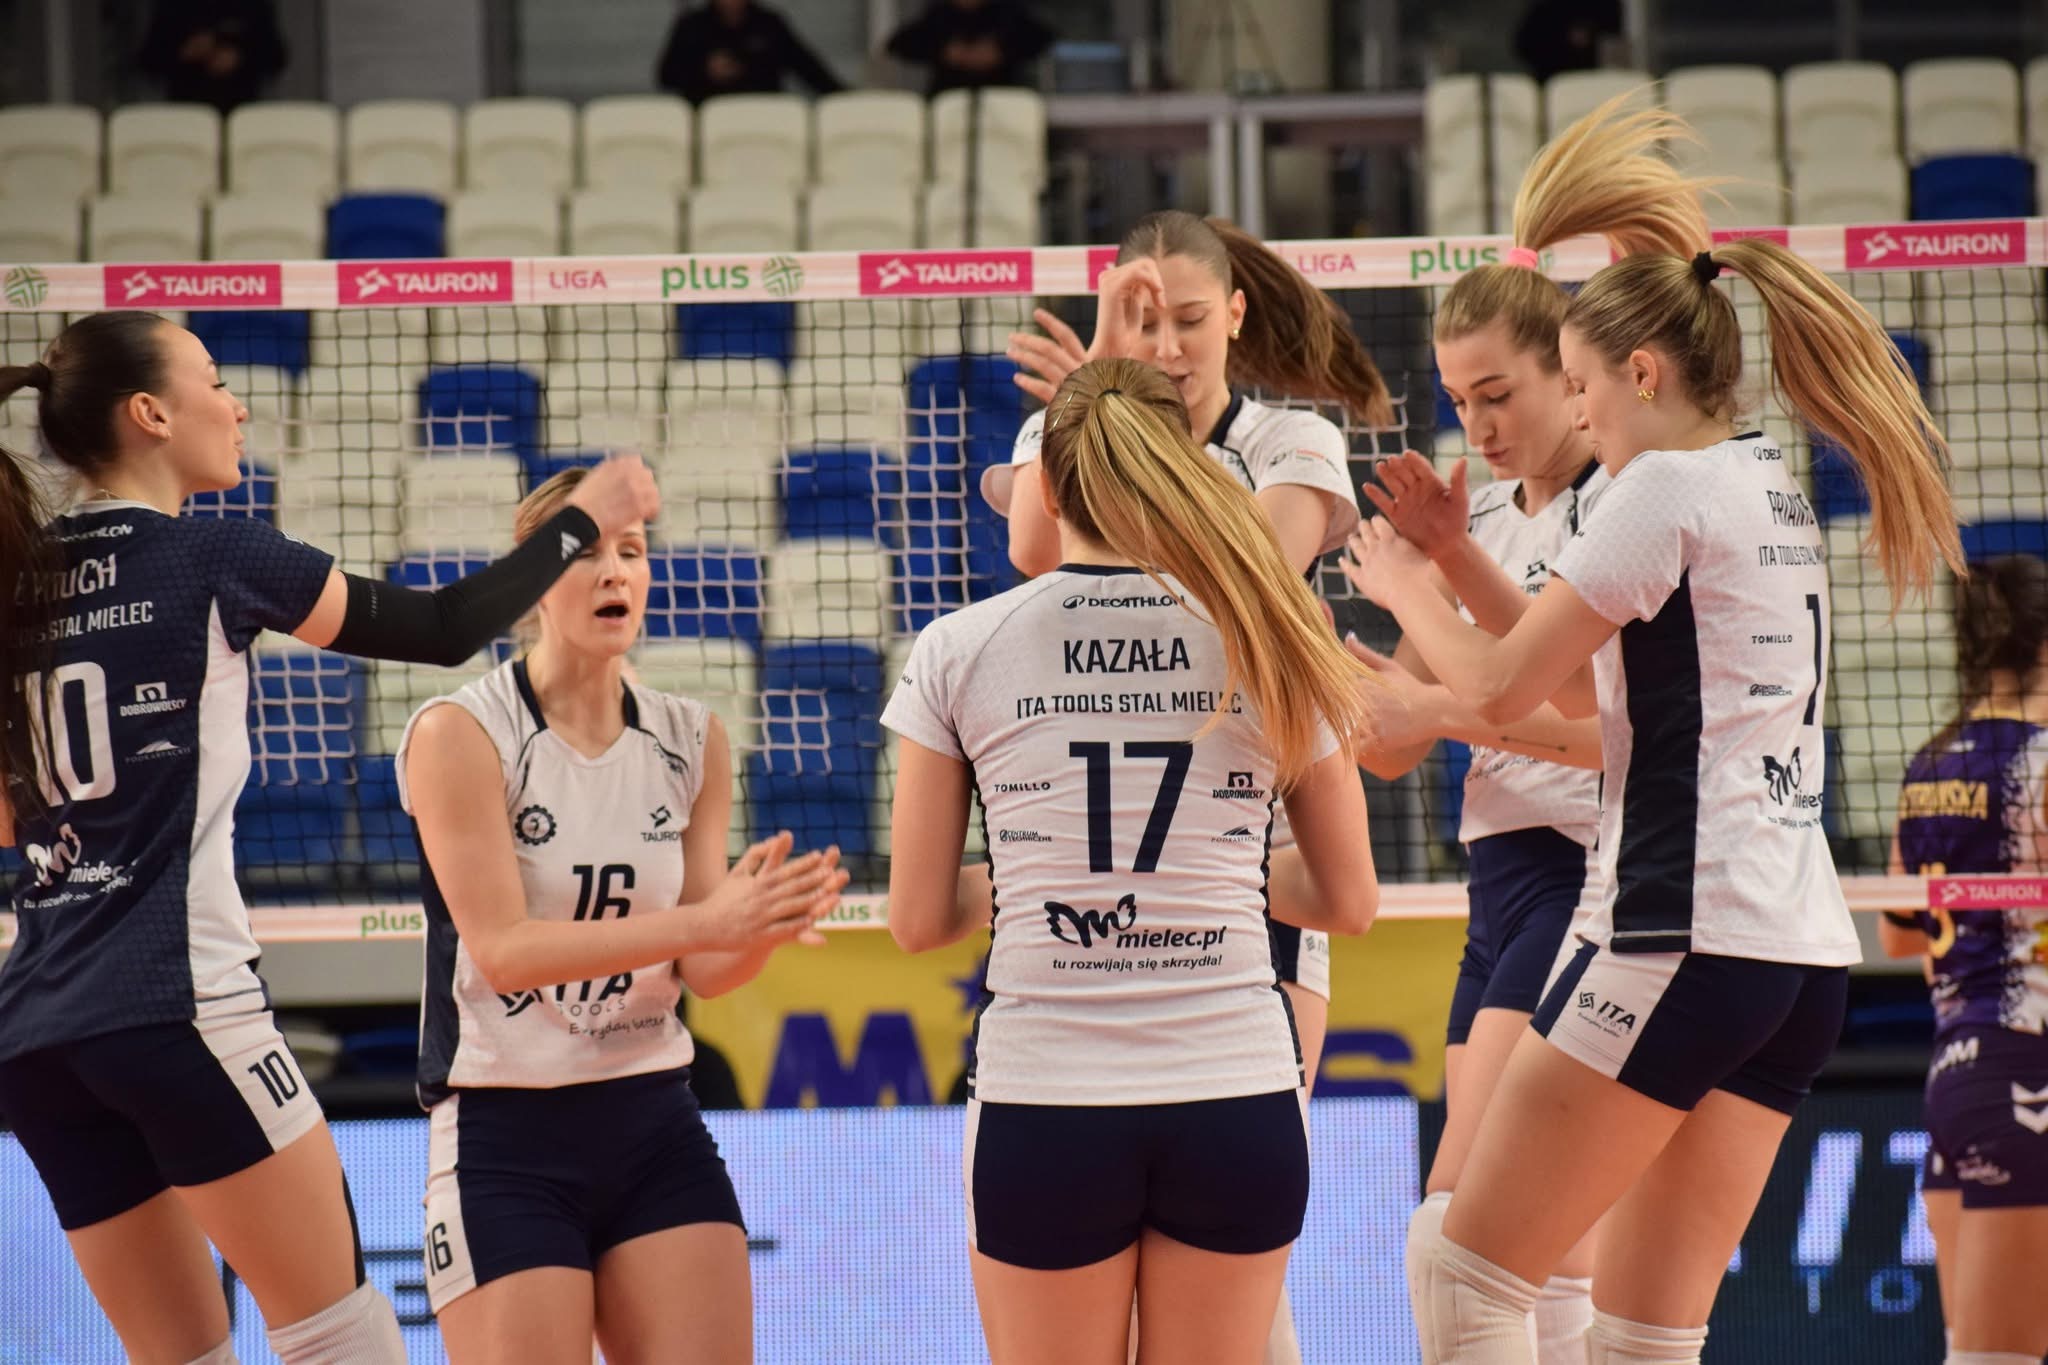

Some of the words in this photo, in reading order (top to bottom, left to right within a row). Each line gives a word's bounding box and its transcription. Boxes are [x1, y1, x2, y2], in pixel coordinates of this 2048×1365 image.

[1903, 234, 2010, 257] TAURON
[914, 262, 1018, 285] TAURON
[1299, 254, 1355, 274] LIGA
[1410, 241, 1498, 280] plus
[162, 275, 267, 297] TAURON
[393, 270, 498, 294] TAURON
[549, 270, 607, 289] LIGA
[661, 259, 750, 298] plus
[87, 601, 153, 632] MIELEC
[1064, 637, 1191, 674] KAZAŁA
[120, 699, 187, 717] DOBROWOLSCY
[1016, 697, 1046, 719] ITA
[1051, 694, 1113, 713] TOOLS
[1119, 692, 1167, 713] STAL
[1171, 690, 1242, 715] MIELC
[20, 662, 116, 807] 10
[1069, 741, 1194, 873] 17
[573, 864, 635, 920] 16
[1967, 884, 2043, 900] TAURON
[361, 909, 422, 938] plus
[1116, 926, 1227, 950] mielec.pl
[1053, 958, 1066, 969] tu
[1070, 958, 1133, 972] rozwijają
[1137, 958, 1158, 971] się
[1161, 954, 1223, 971] skrzydła!
[1599, 1000, 1636, 1030] ITA
[248, 1050, 299, 1109] 10
[427, 1221, 453, 1276] 16
